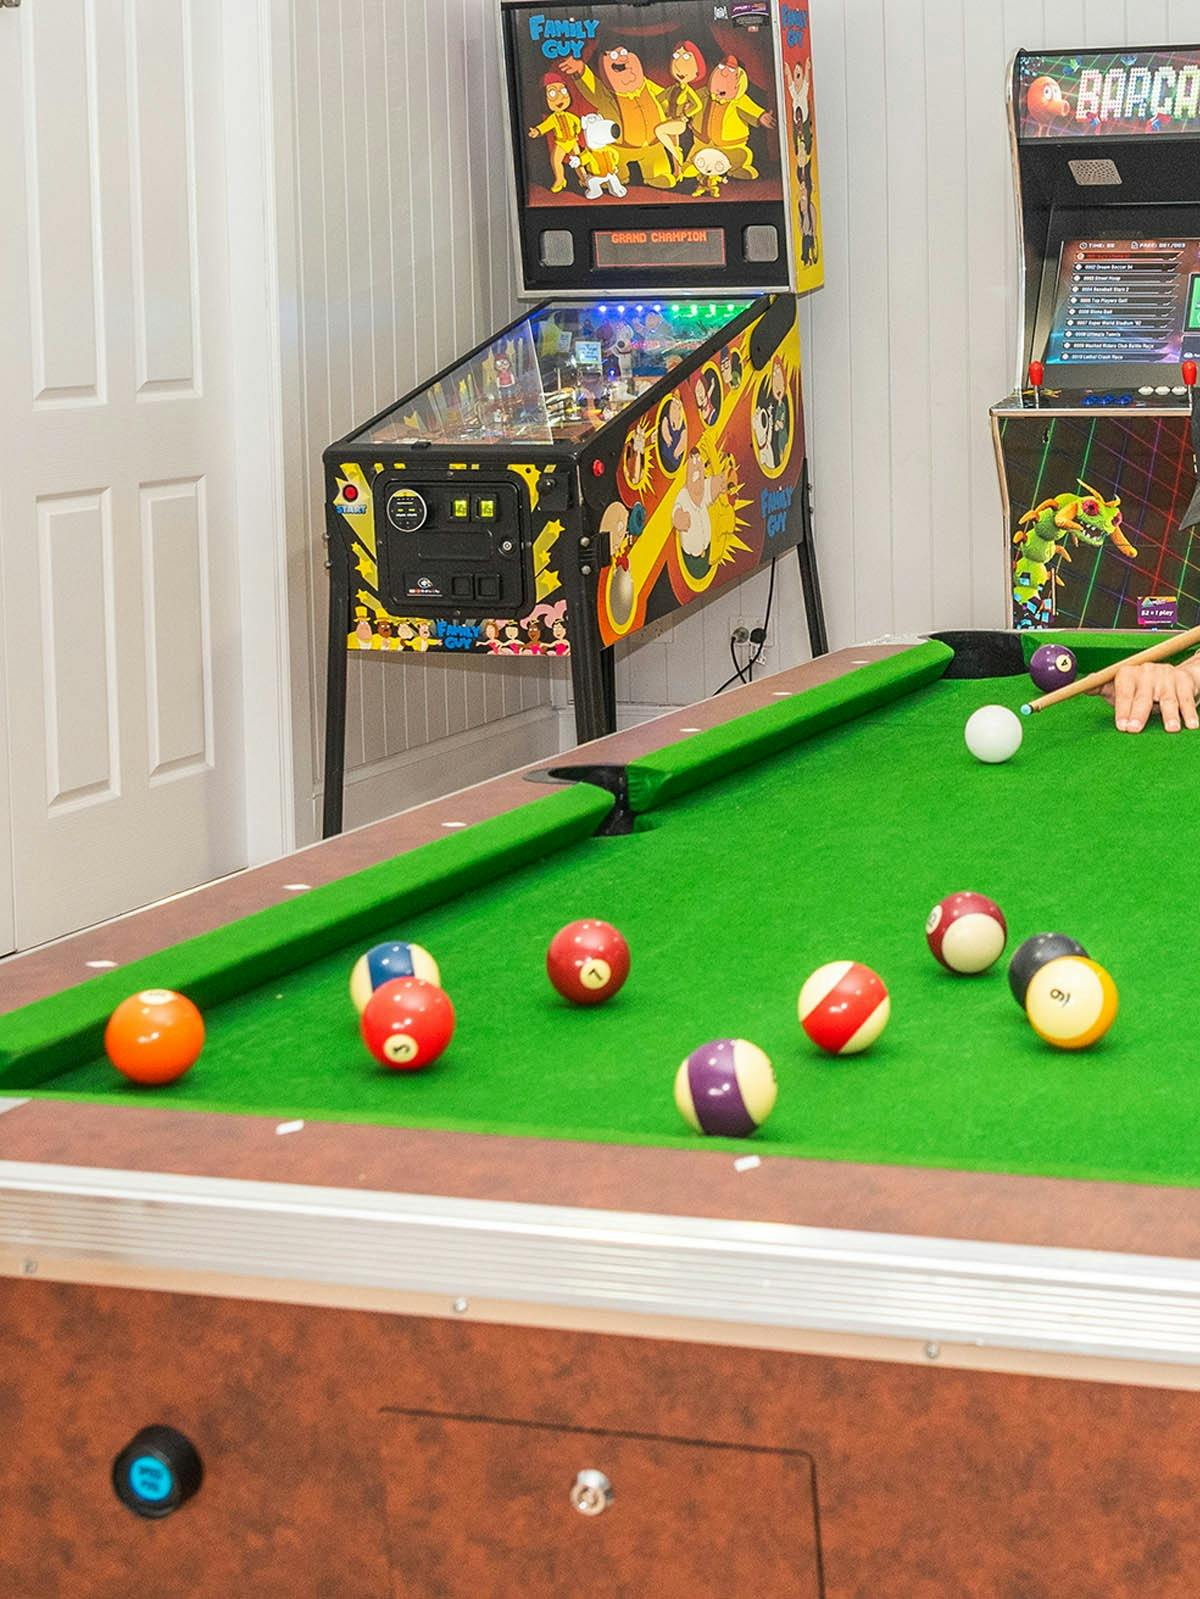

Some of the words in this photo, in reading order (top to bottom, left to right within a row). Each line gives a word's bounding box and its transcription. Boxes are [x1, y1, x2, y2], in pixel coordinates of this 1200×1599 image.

[529, 14, 600, 41] FAMILY
[542, 39, 585, 59] GUY
[611, 231, 647, 244] GRAND
[651, 230, 707, 243] CHAMPION
[335, 504, 367, 514] START
[588, 967, 604, 982] 7
